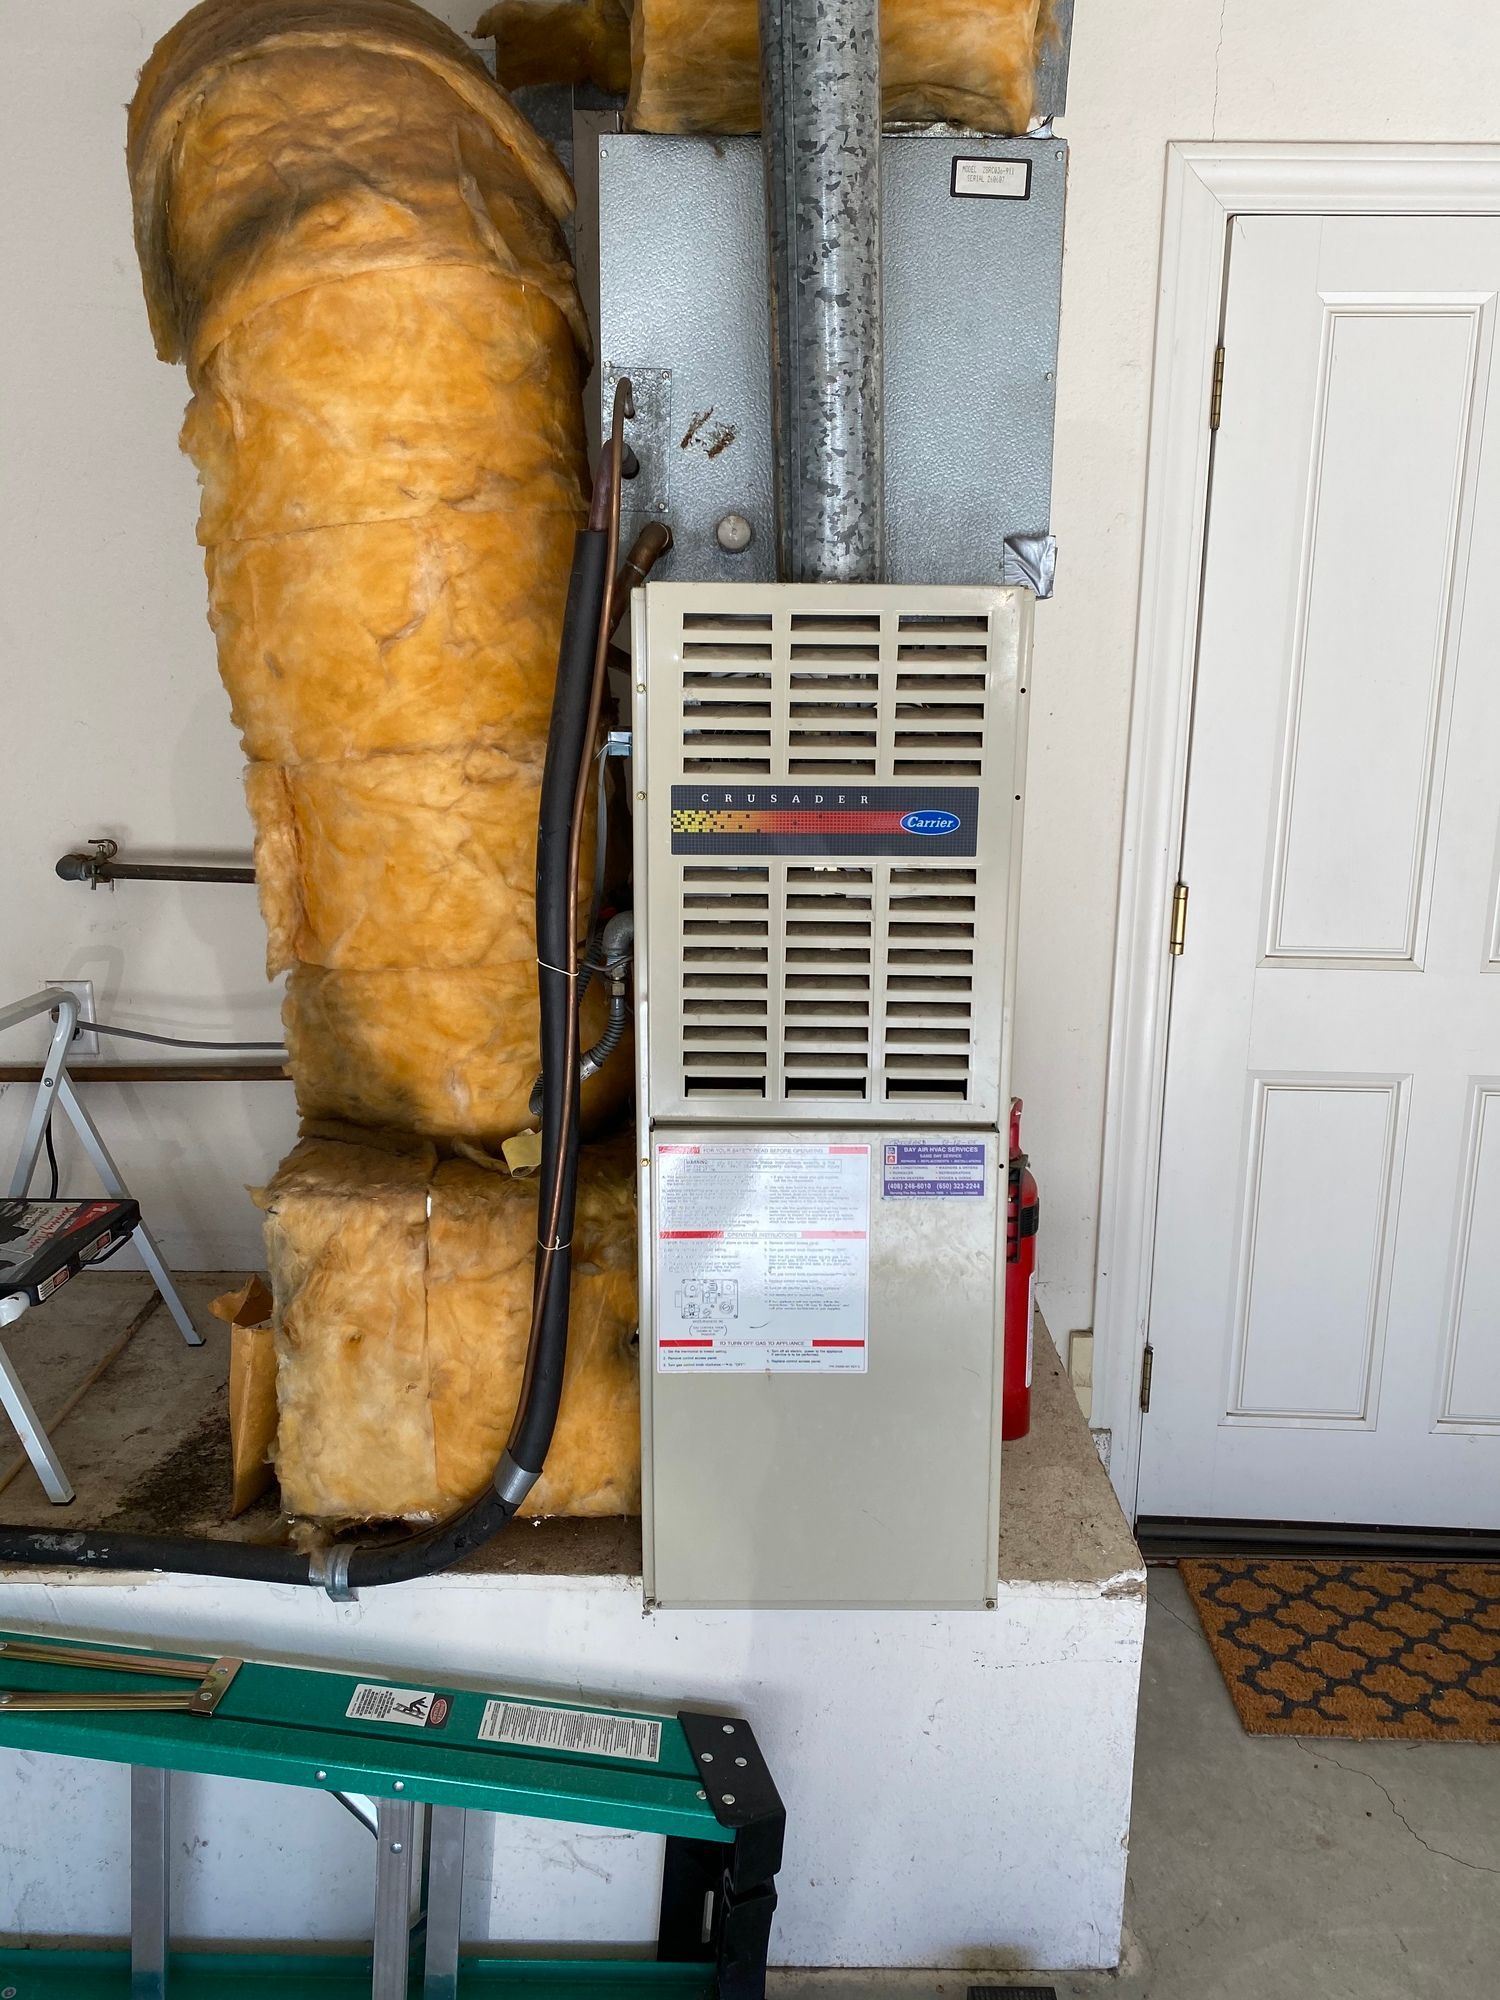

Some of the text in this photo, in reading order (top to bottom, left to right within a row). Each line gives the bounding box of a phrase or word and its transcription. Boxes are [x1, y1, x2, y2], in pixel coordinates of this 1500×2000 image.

[701, 793, 870, 804] CRUSADER
[906, 816, 954, 829] Carrier
[887, 1182, 903, 1190] (408)
[936, 1182, 952, 1190] (650)
